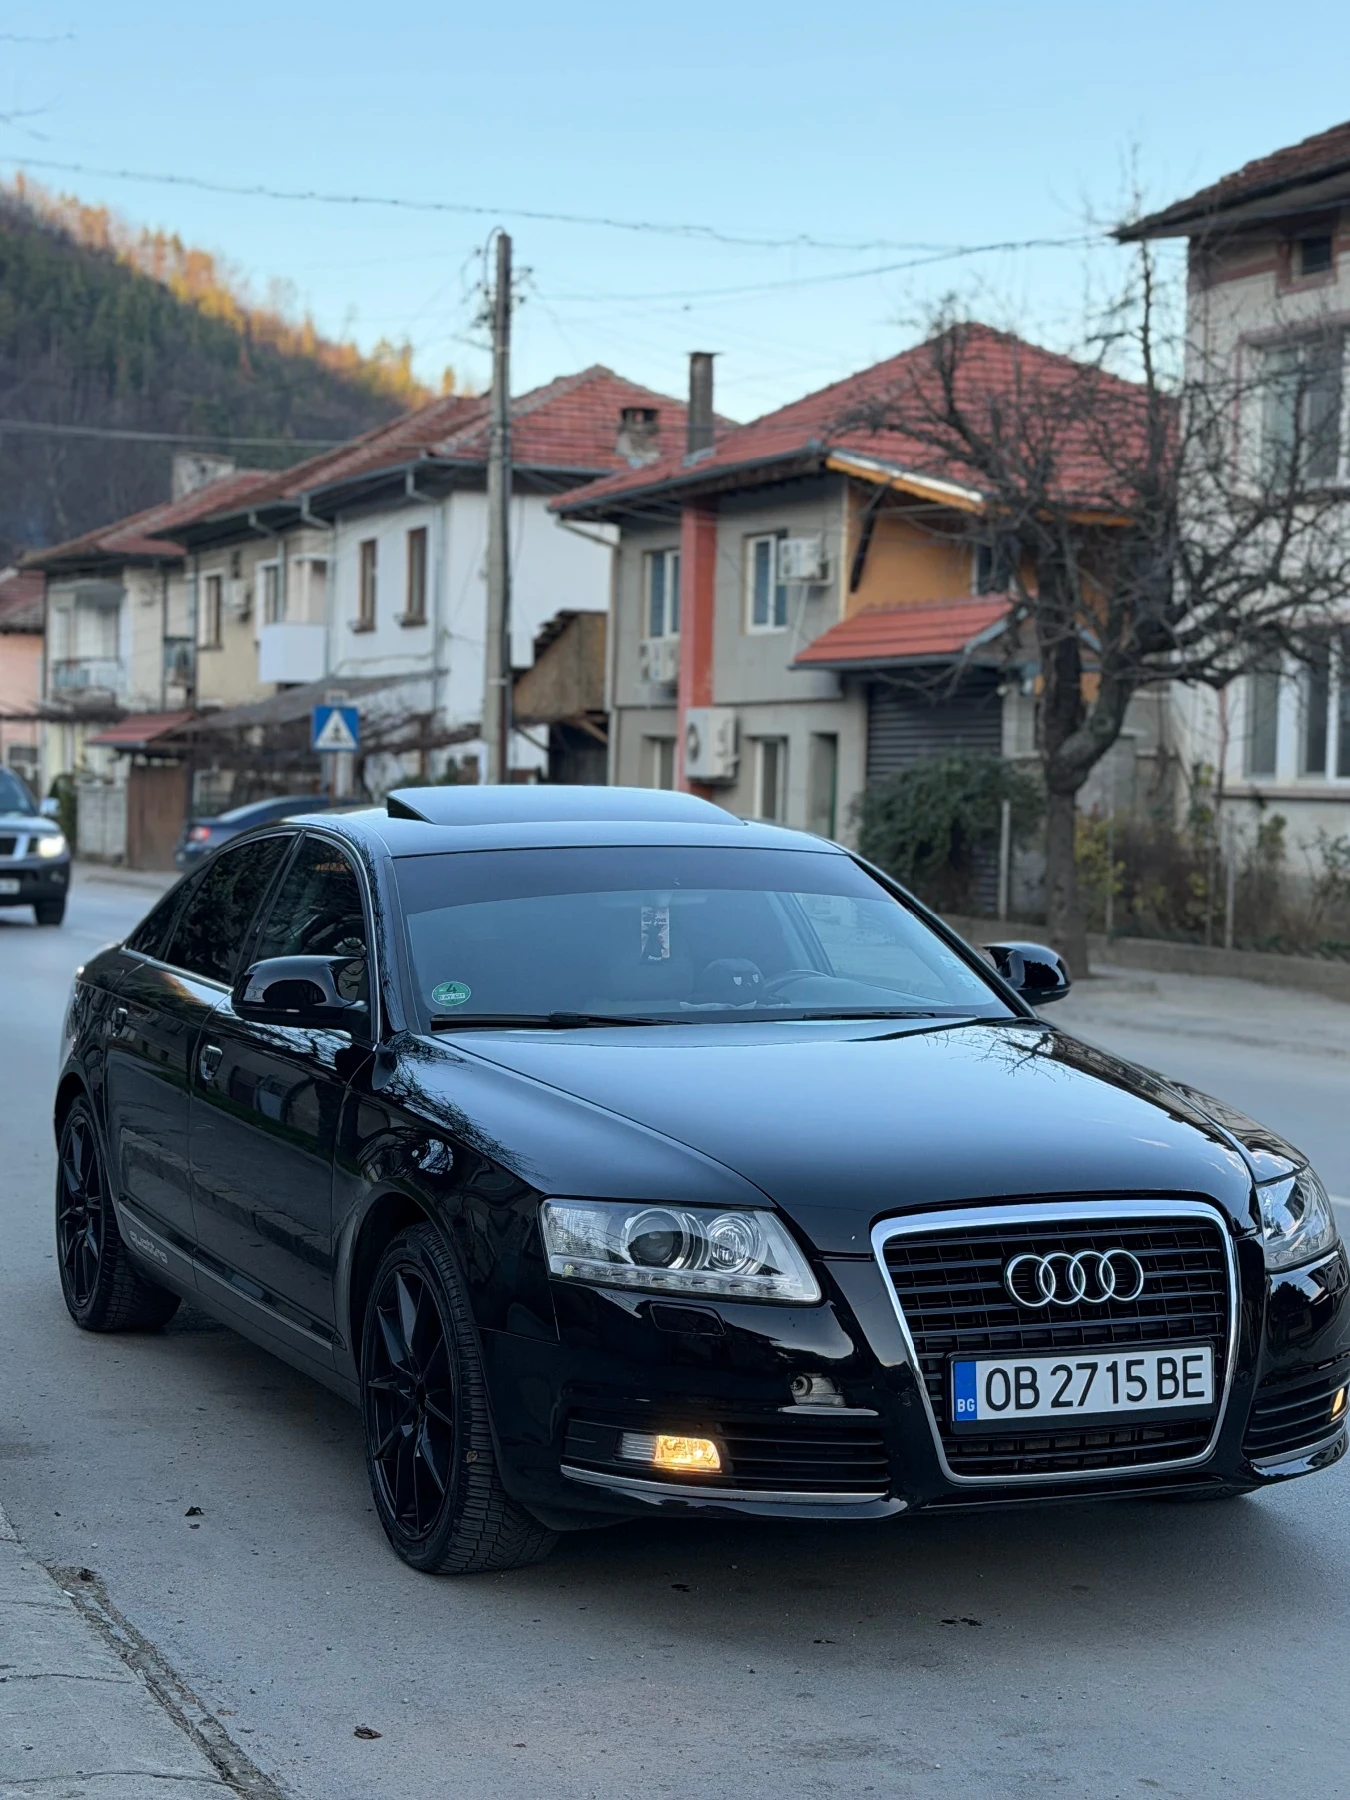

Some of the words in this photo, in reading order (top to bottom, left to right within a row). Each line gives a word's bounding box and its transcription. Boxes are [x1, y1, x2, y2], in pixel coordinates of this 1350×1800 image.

[129, 1230, 168, 1264] quattro
[985, 1366, 1040, 1411] OB
[1050, 1359, 1147, 1408] 2715
[1157, 1354, 1205, 1400] BE
[957, 1398, 975, 1413] BG
